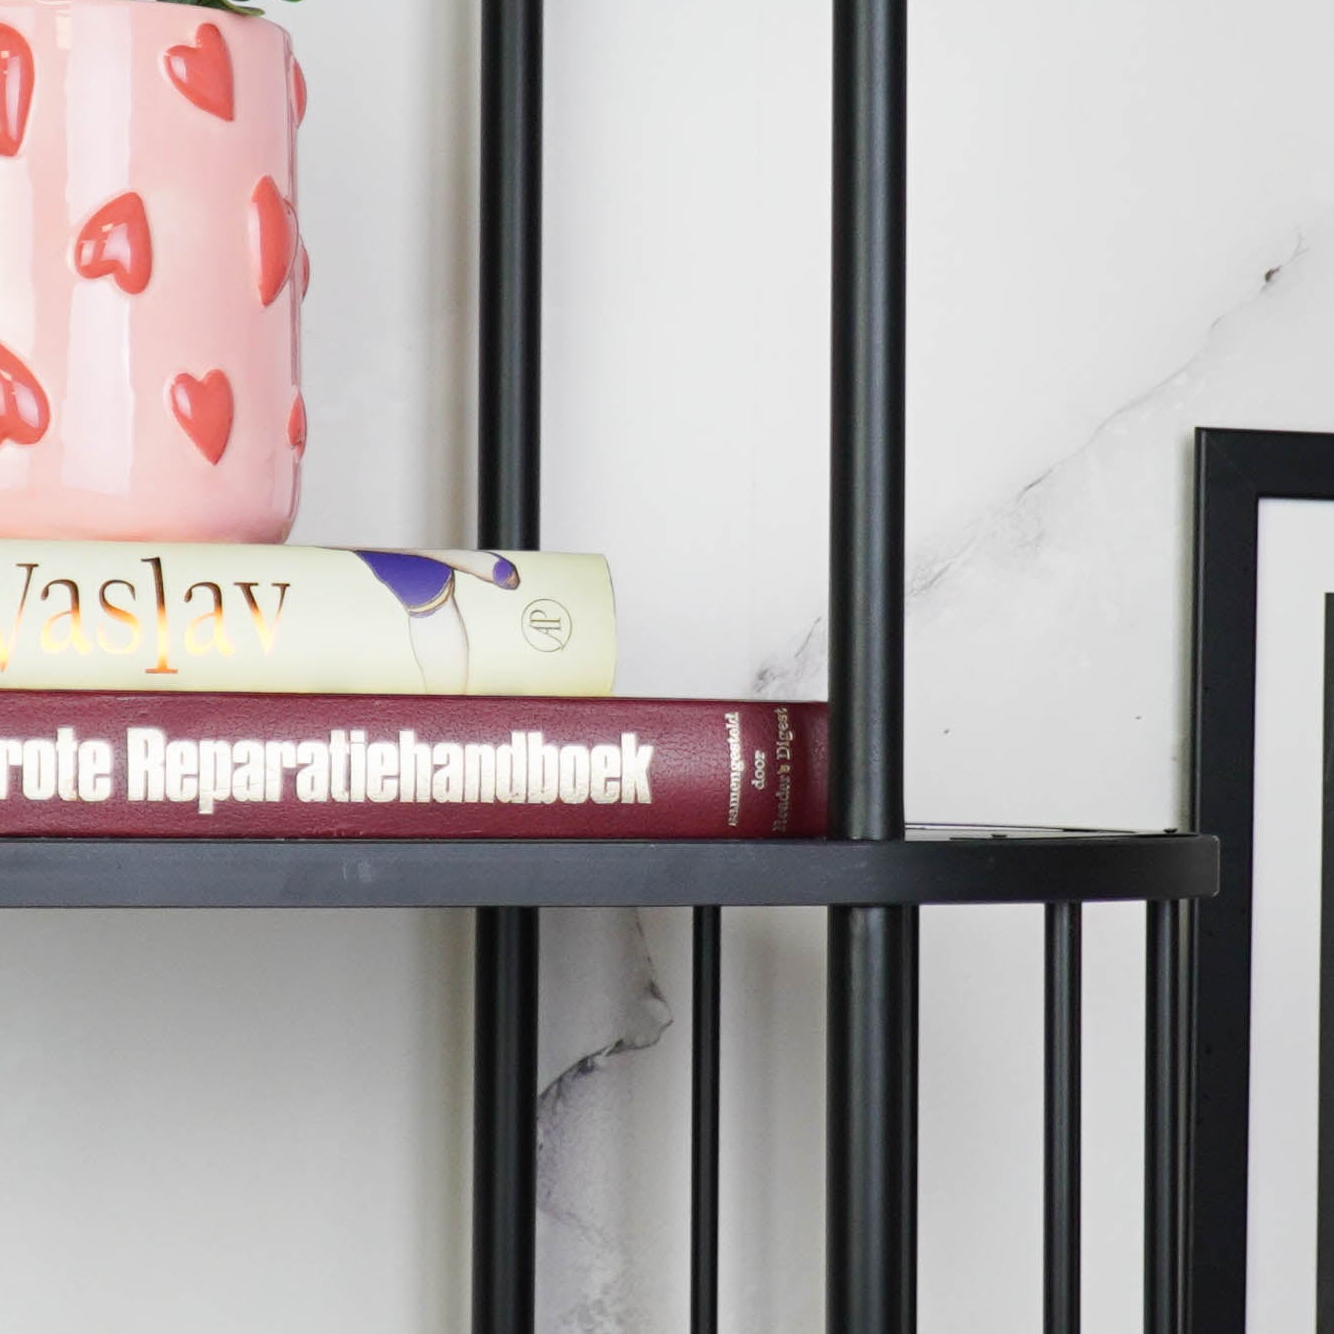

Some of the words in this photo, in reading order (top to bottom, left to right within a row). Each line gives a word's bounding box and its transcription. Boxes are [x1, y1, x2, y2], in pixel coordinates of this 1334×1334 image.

[724, 711, 745, 827] samengesteld
[774, 708, 794, 760] Digest
[126, 726, 655, 815] Reparatiehandboek
[751, 750, 766, 791] door
